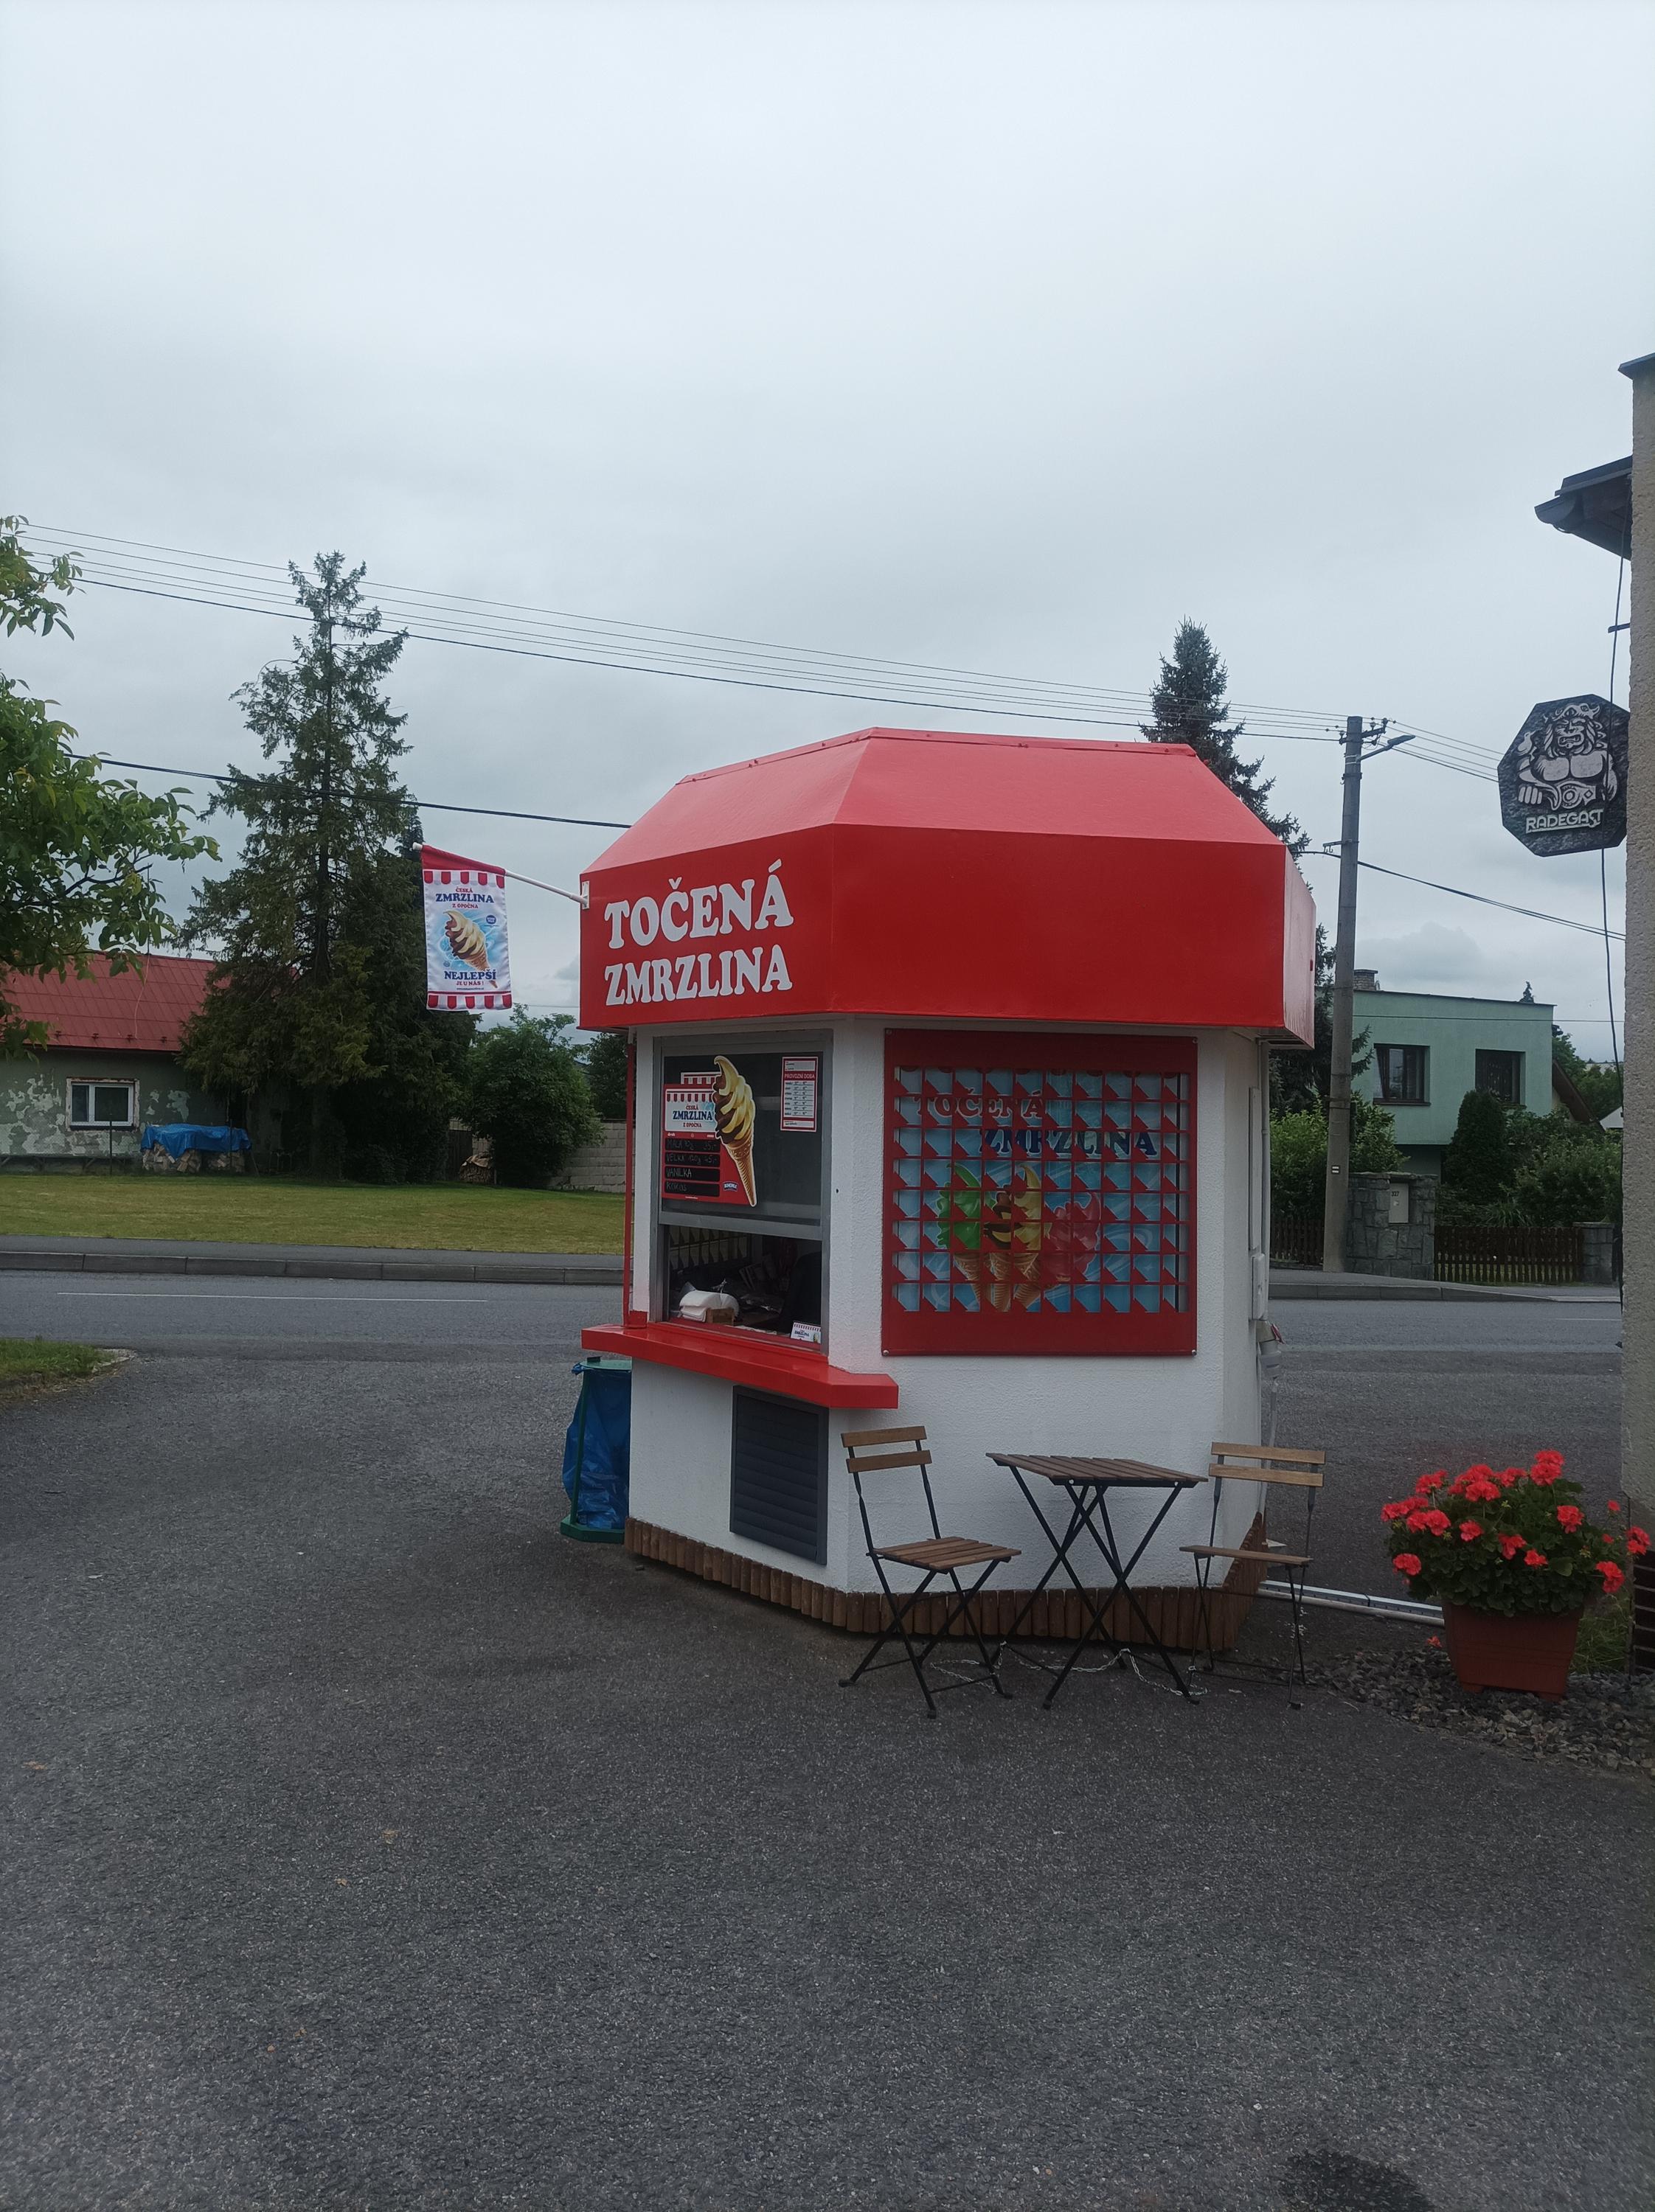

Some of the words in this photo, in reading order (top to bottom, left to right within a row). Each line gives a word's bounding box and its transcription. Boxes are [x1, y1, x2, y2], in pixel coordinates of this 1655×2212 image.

[1526, 809, 1603, 833] RADEGAST
[435, 893, 495, 903] ZMRZLINA
[604, 858, 794, 949] TOČENÁ
[444, 969, 496, 980] NEJLEPŠÍ
[604, 945, 793, 1006] ZMRZLINA
[673, 1110, 712, 1120] ZMRZLINA
